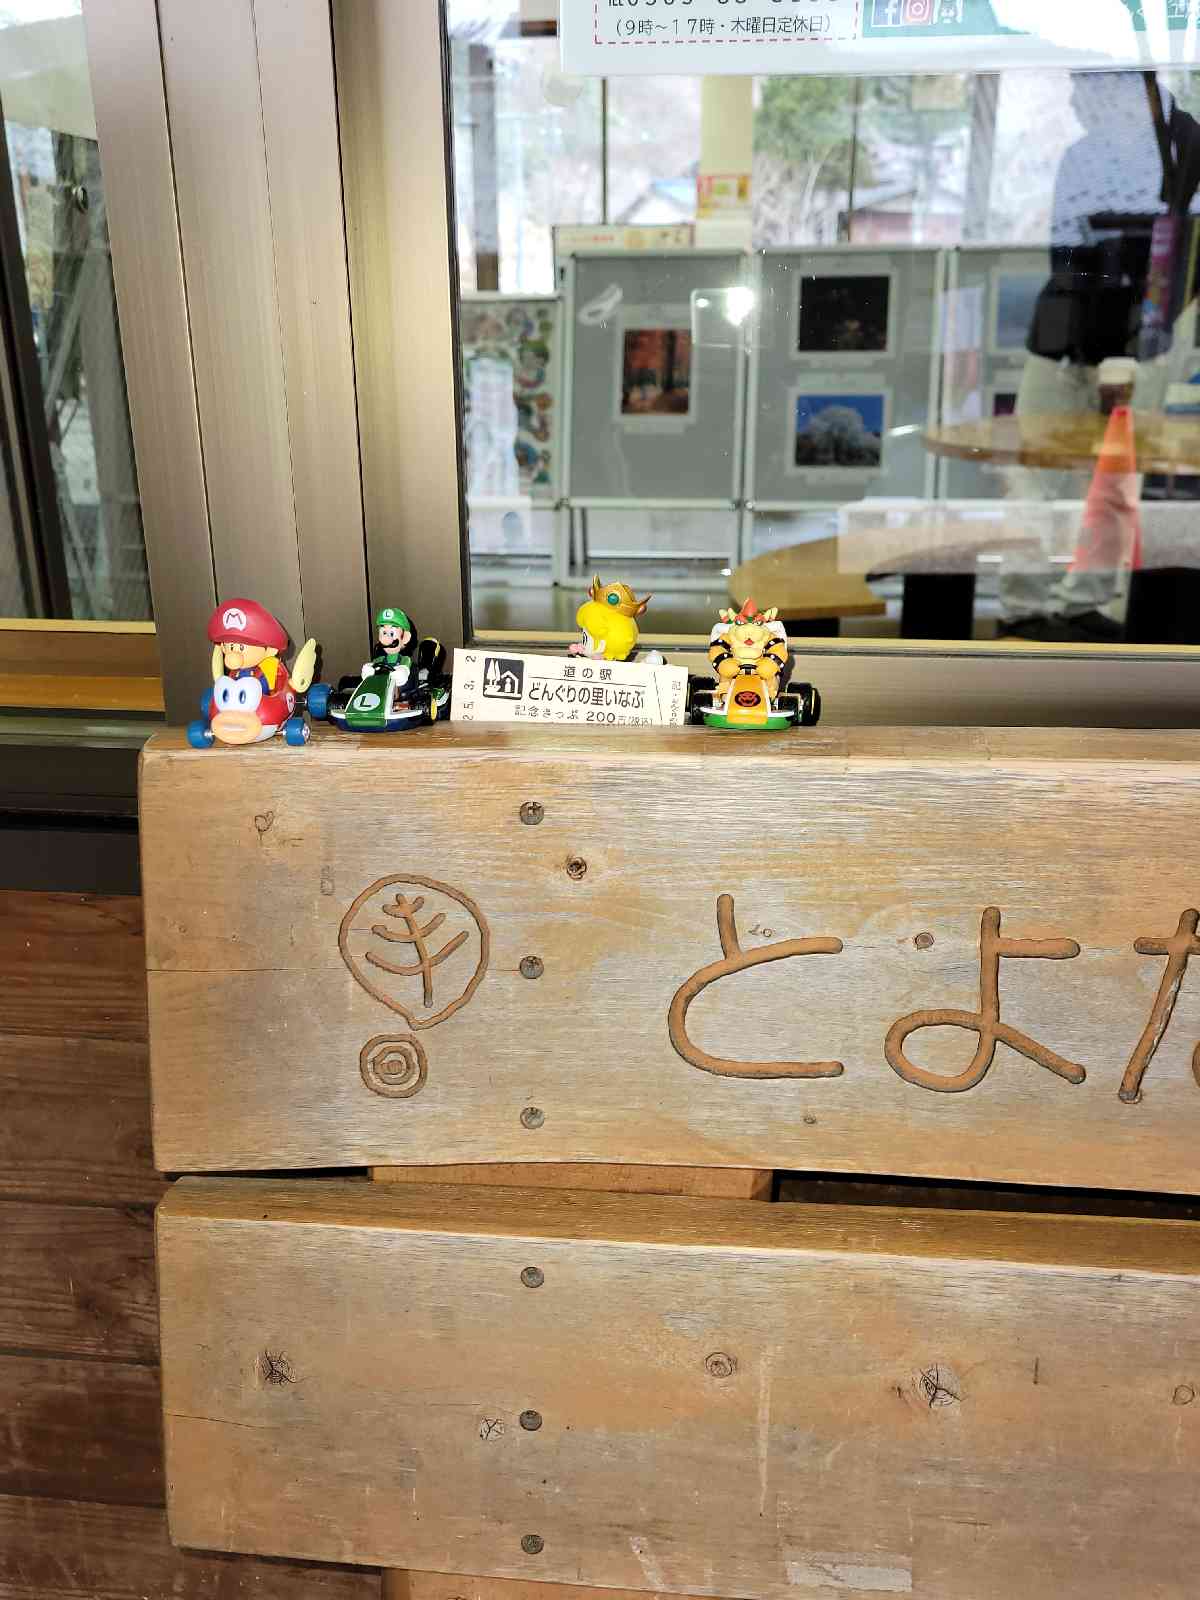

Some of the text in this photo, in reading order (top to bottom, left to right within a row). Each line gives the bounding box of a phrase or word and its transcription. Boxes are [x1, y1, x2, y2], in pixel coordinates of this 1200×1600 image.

[226, 612, 243, 625] M
[563, 665, 612, 680] 道の駅
[359, 695, 371, 708] L
